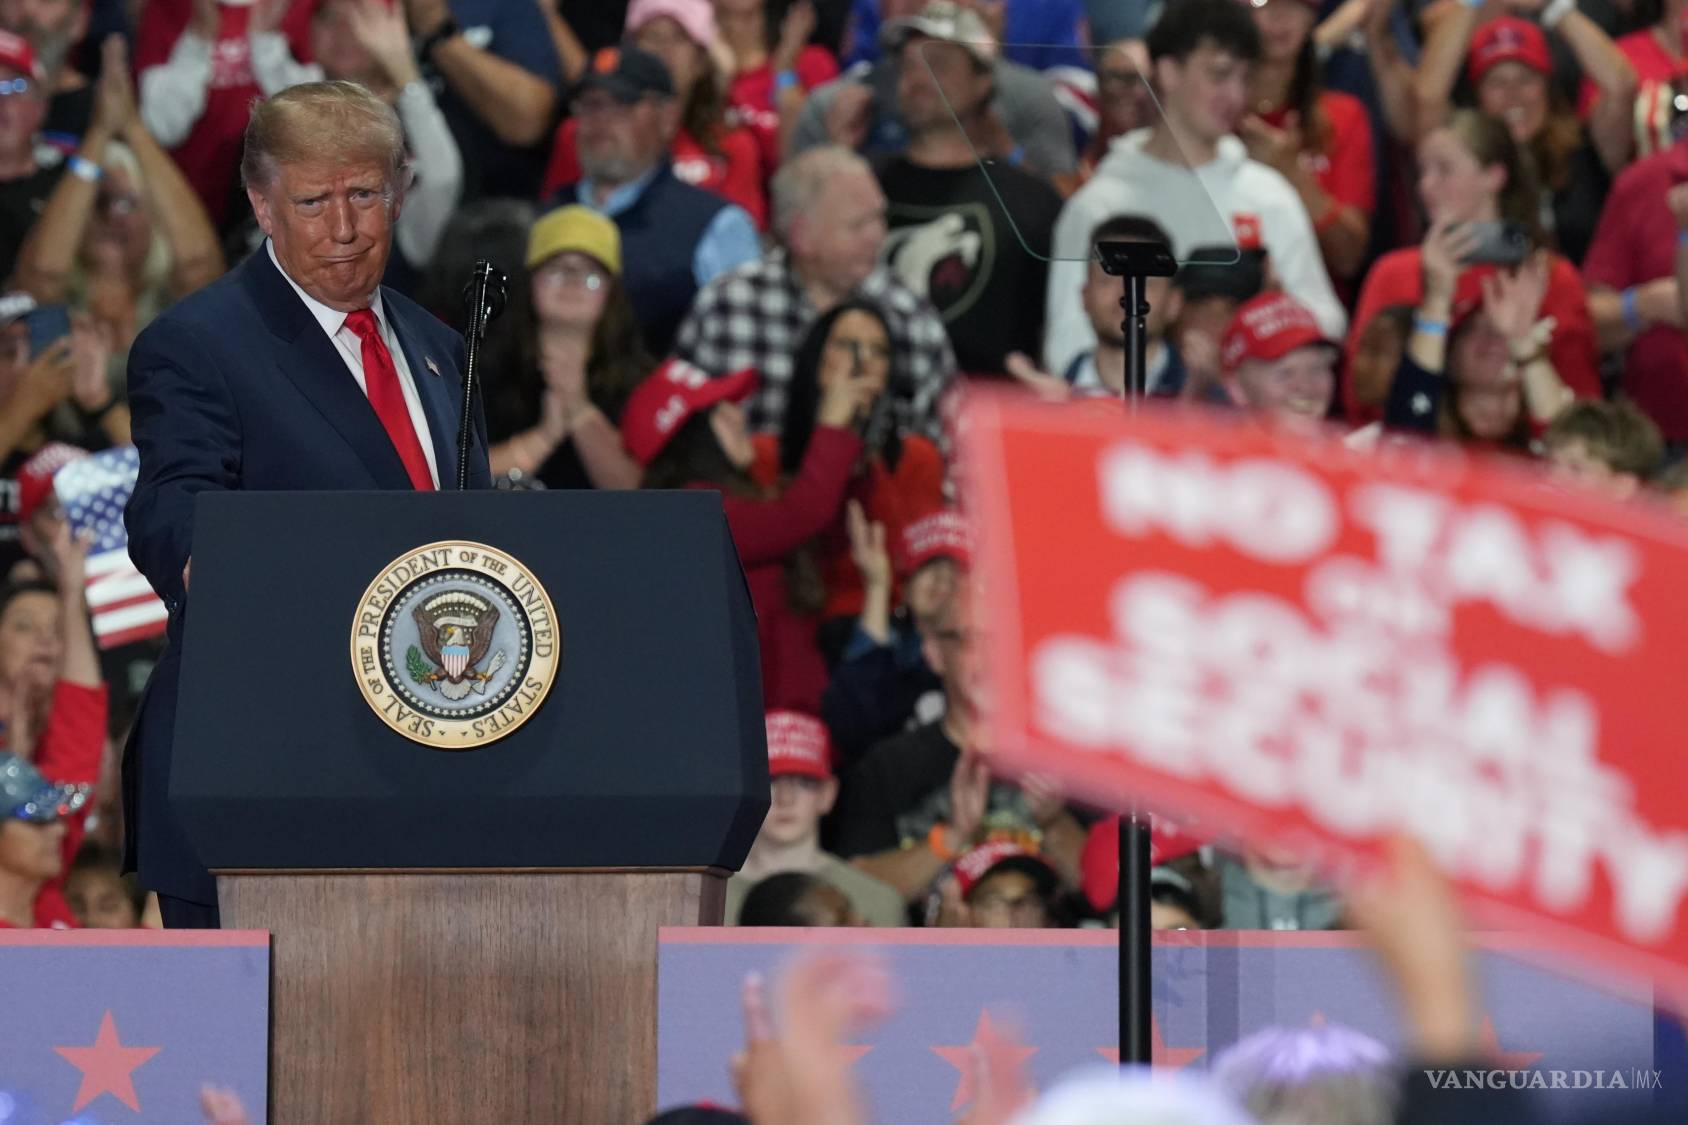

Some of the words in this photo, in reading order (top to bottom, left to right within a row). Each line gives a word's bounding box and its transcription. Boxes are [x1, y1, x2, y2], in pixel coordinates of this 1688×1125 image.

[459, 550, 479, 564] OF
[482, 555, 508, 576] THE
[1099, 440, 1339, 564] NO
[1349, 481, 1640, 656] TAX
[358, 548, 453, 638] PRESIDENT
[512, 572, 553, 658] UNITED
[360, 646, 376, 675] THE
[368, 677, 384, 695] OF
[383, 698, 435, 738] SEAL
[472, 676, 543, 738] STATES
